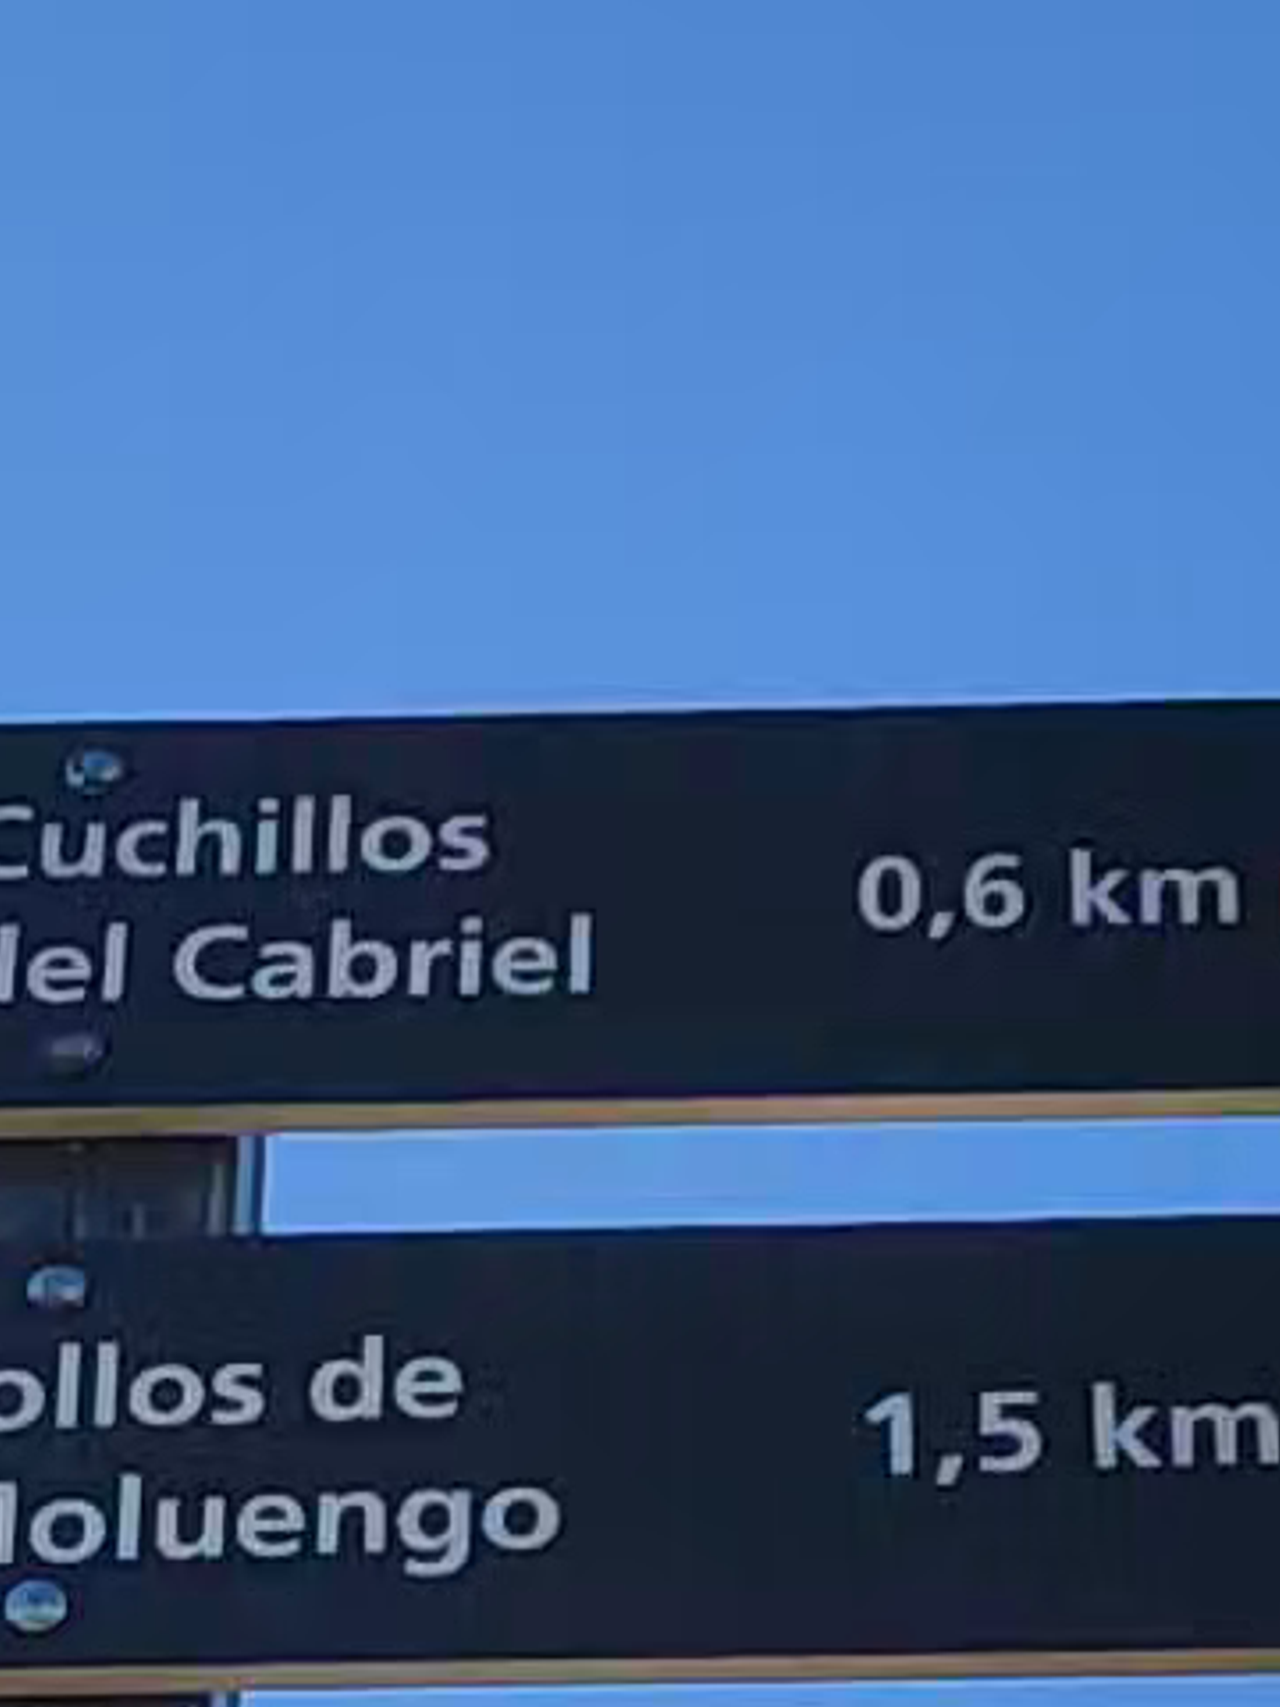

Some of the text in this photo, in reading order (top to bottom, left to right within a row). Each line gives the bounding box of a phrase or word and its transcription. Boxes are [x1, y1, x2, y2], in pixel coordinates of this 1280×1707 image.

[858, 847, 1239, 939] 0,6 km
[173, 914, 592, 1000] Cabriel
[308, 1334, 464, 1422] de
[864, 1381, 1280, 1486] 1,5 km
